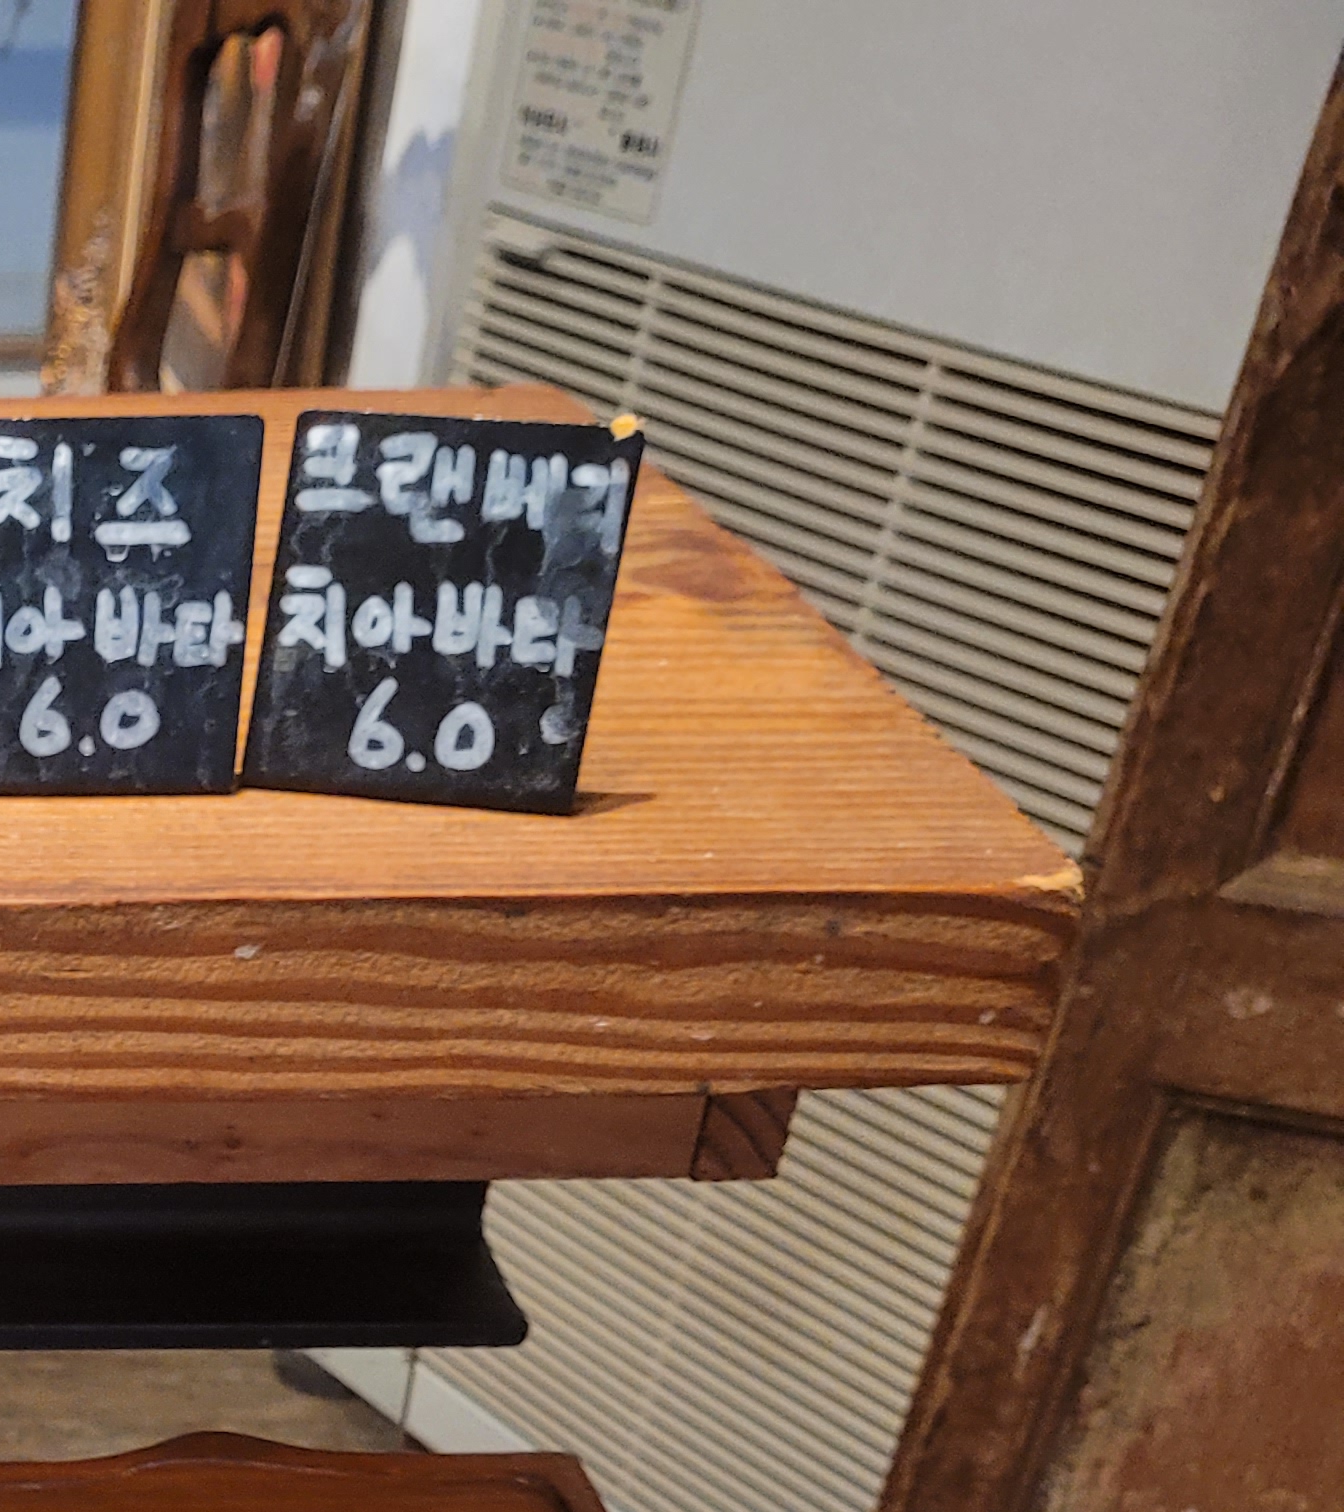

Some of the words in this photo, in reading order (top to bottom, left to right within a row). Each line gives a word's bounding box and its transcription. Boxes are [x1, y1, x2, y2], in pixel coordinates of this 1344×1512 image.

[278, 564, 604, 677] 치아바타
[18, 675, 161, 758] 6.0
[347, 676, 497, 773] 6.0
